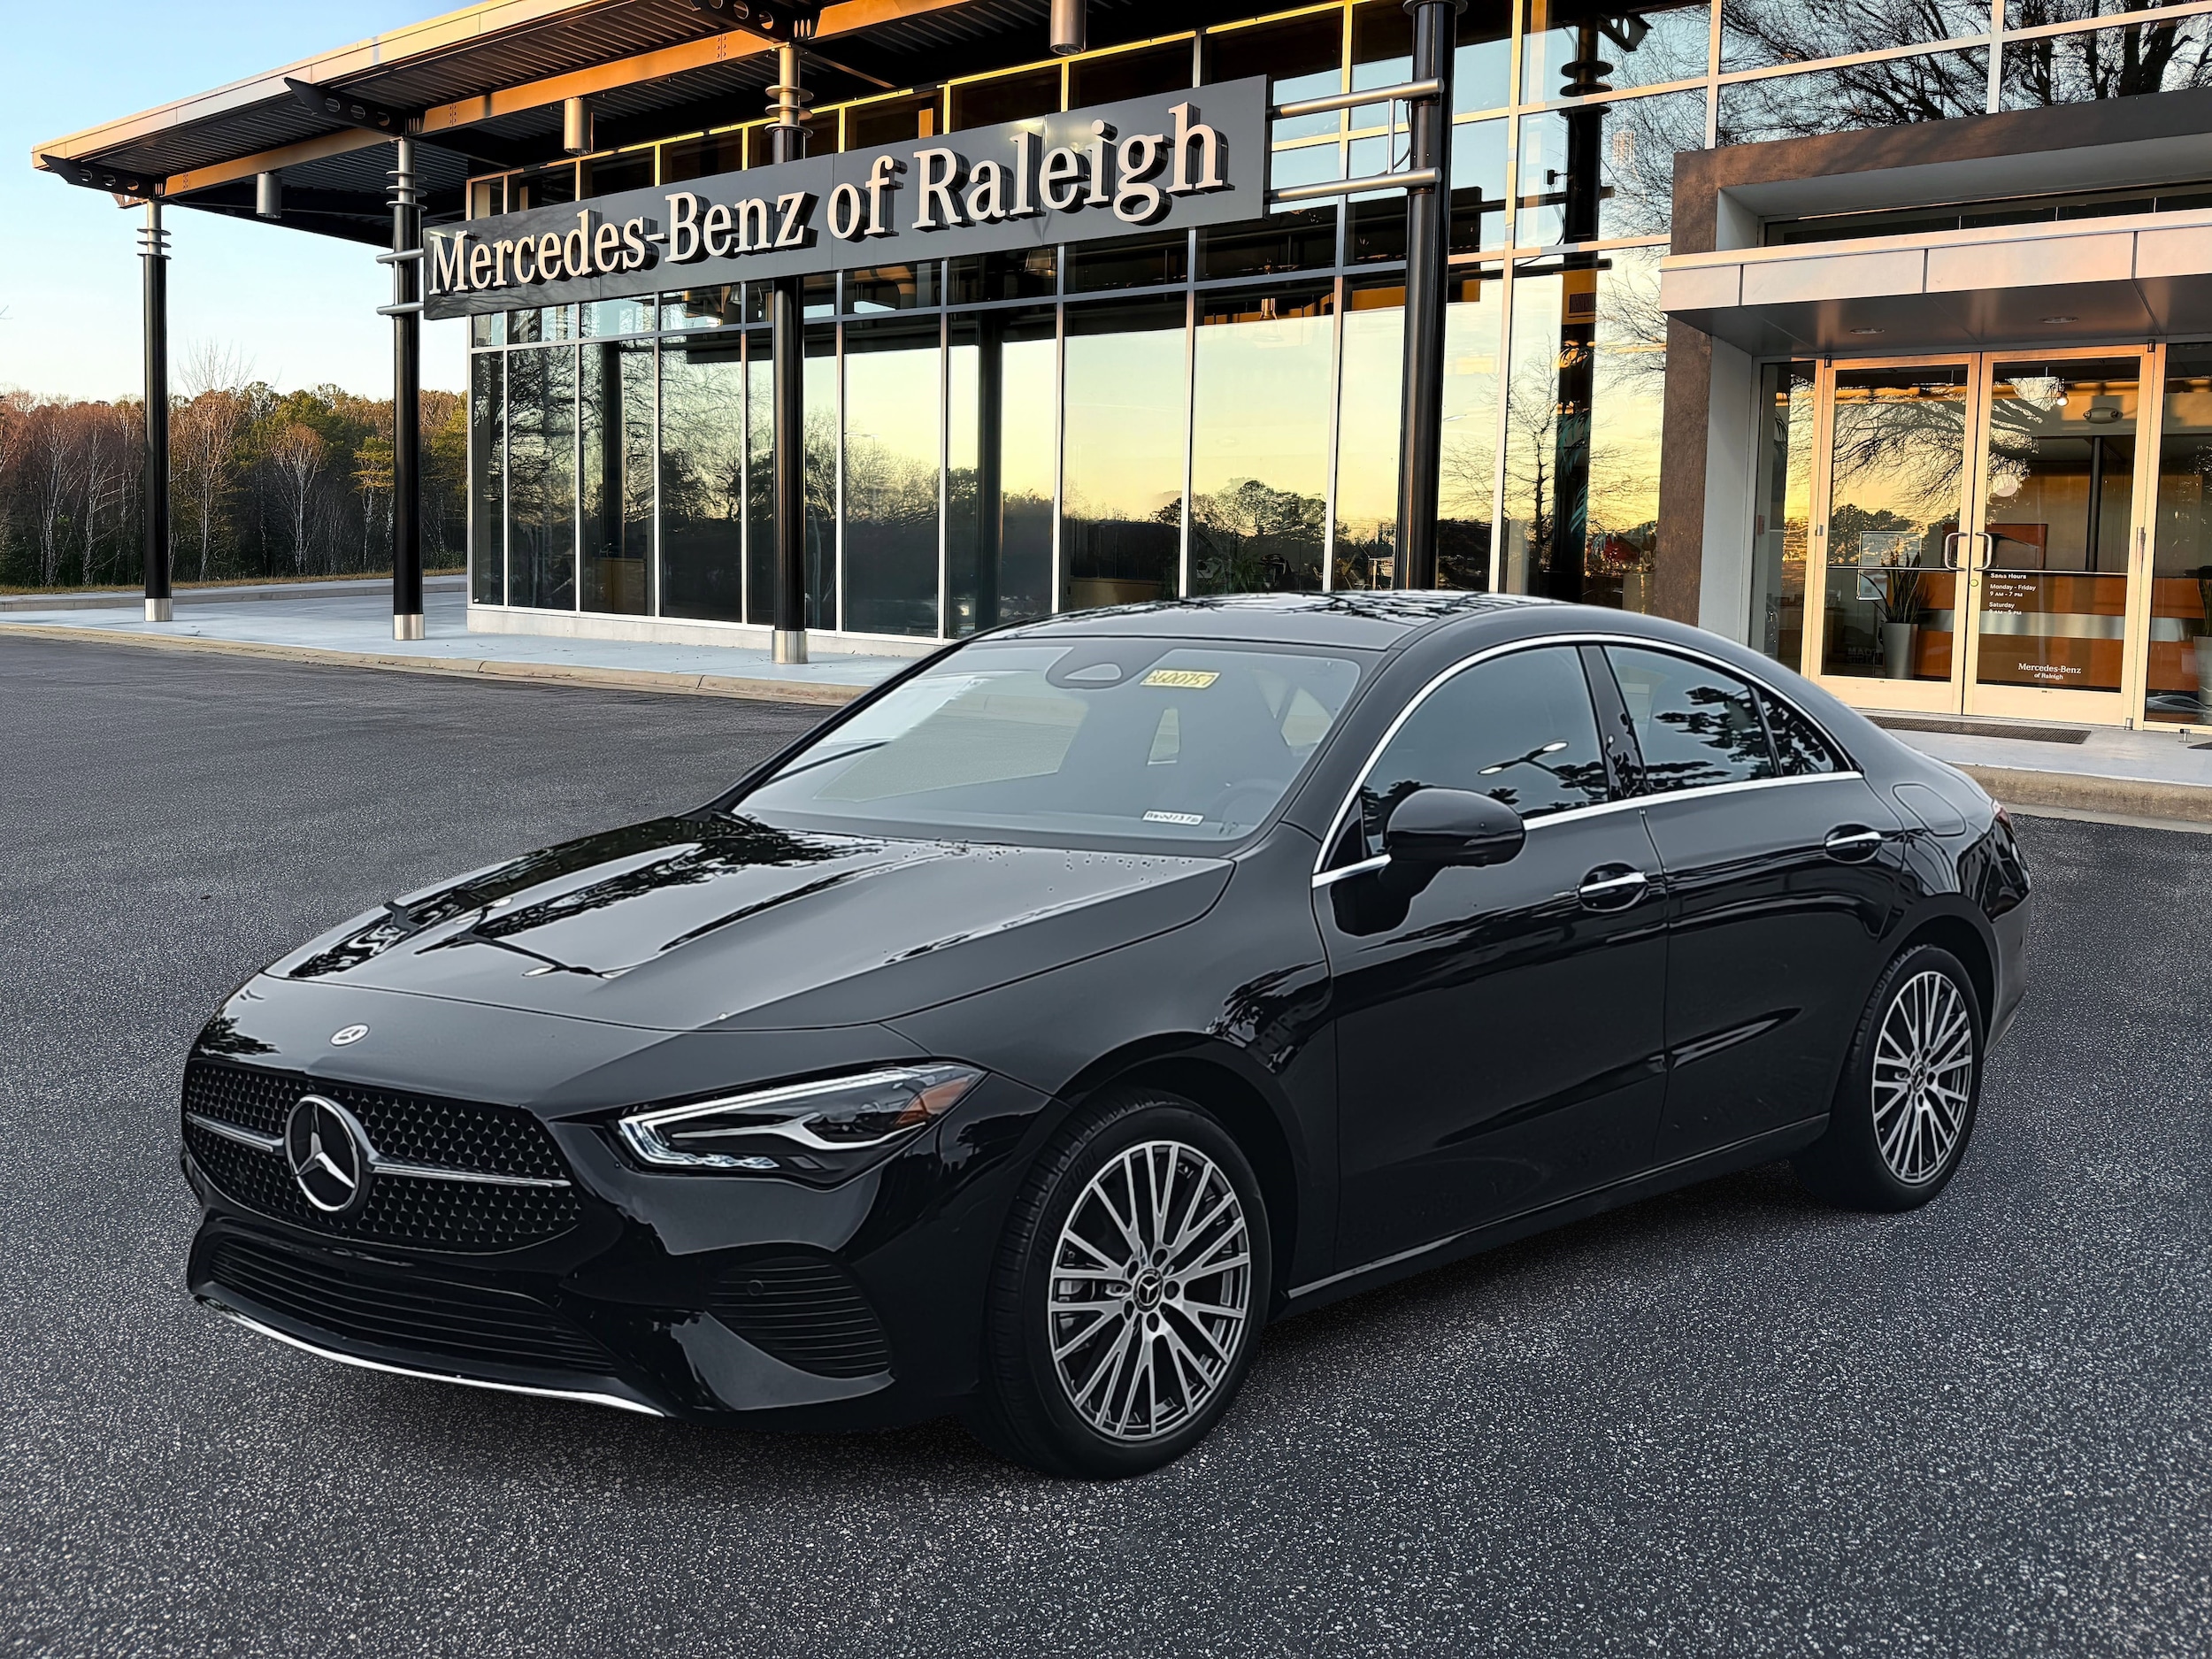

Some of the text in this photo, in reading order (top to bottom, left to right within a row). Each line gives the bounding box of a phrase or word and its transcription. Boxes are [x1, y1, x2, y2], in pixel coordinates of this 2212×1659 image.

[428, 102, 1224, 295] Mercedes-Benz of Raleigh
[2018, 663, 2082, 674] Mercedes-Benz
